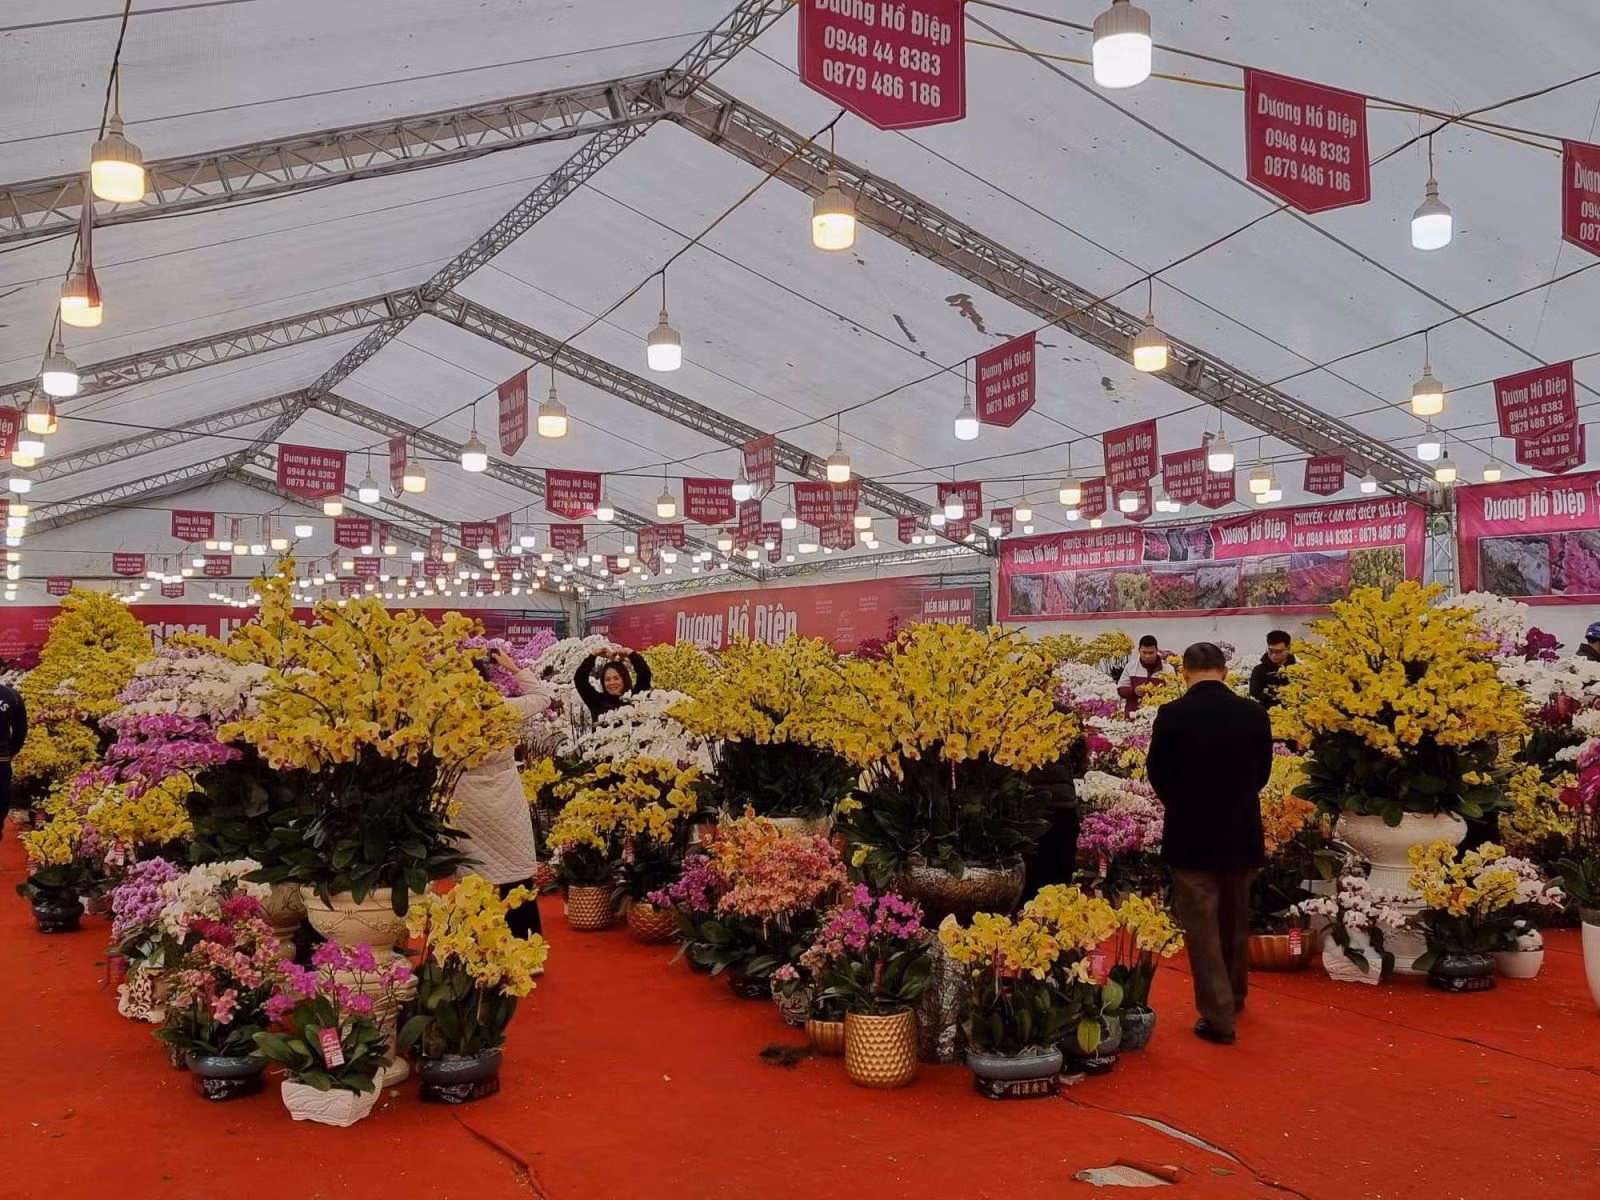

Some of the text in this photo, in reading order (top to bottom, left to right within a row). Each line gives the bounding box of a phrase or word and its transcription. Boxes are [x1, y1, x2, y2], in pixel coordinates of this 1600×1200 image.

[881, 2, 906, 31] Hồ
[911, 10, 951, 46] Điệp
[824, 26, 941, 76] 0948 44 8383
[822, 59, 941, 108] 0879 486 186
[1257, 92, 1357, 139] Dương Hồ Điệp
[1265, 127, 1350, 165] 0948 44 8383
[1264, 155, 1351, 192] 0879 486 186
[1502, 377, 1567, 406] Dương Hồ Điệp
[1509, 400, 1563, 422] 0948 44 8383
[1510, 413, 1565, 434] 0879 486 186
[286, 477, 336, 490] 0879 486 186
[1329, 509, 1345, 523] LAN
[1484, 495, 1526, 521] Dương
[1530, 487, 1549, 517] Hồ
[1552, 487, 1586, 519] Điệp
[1219, 517, 1287, 545] Dương Hồ Điệp
[1306, 532, 1323, 547] 0948
[1325, 530, 1334, 545] 44
[1335, 528, 1353, 544] 8383
[1360, 526, 1376, 542] 0879
[1378, 525, 1391, 540] 486
[1393, 523, 1406, 539] 186
[676, 611, 722, 649] Dương
